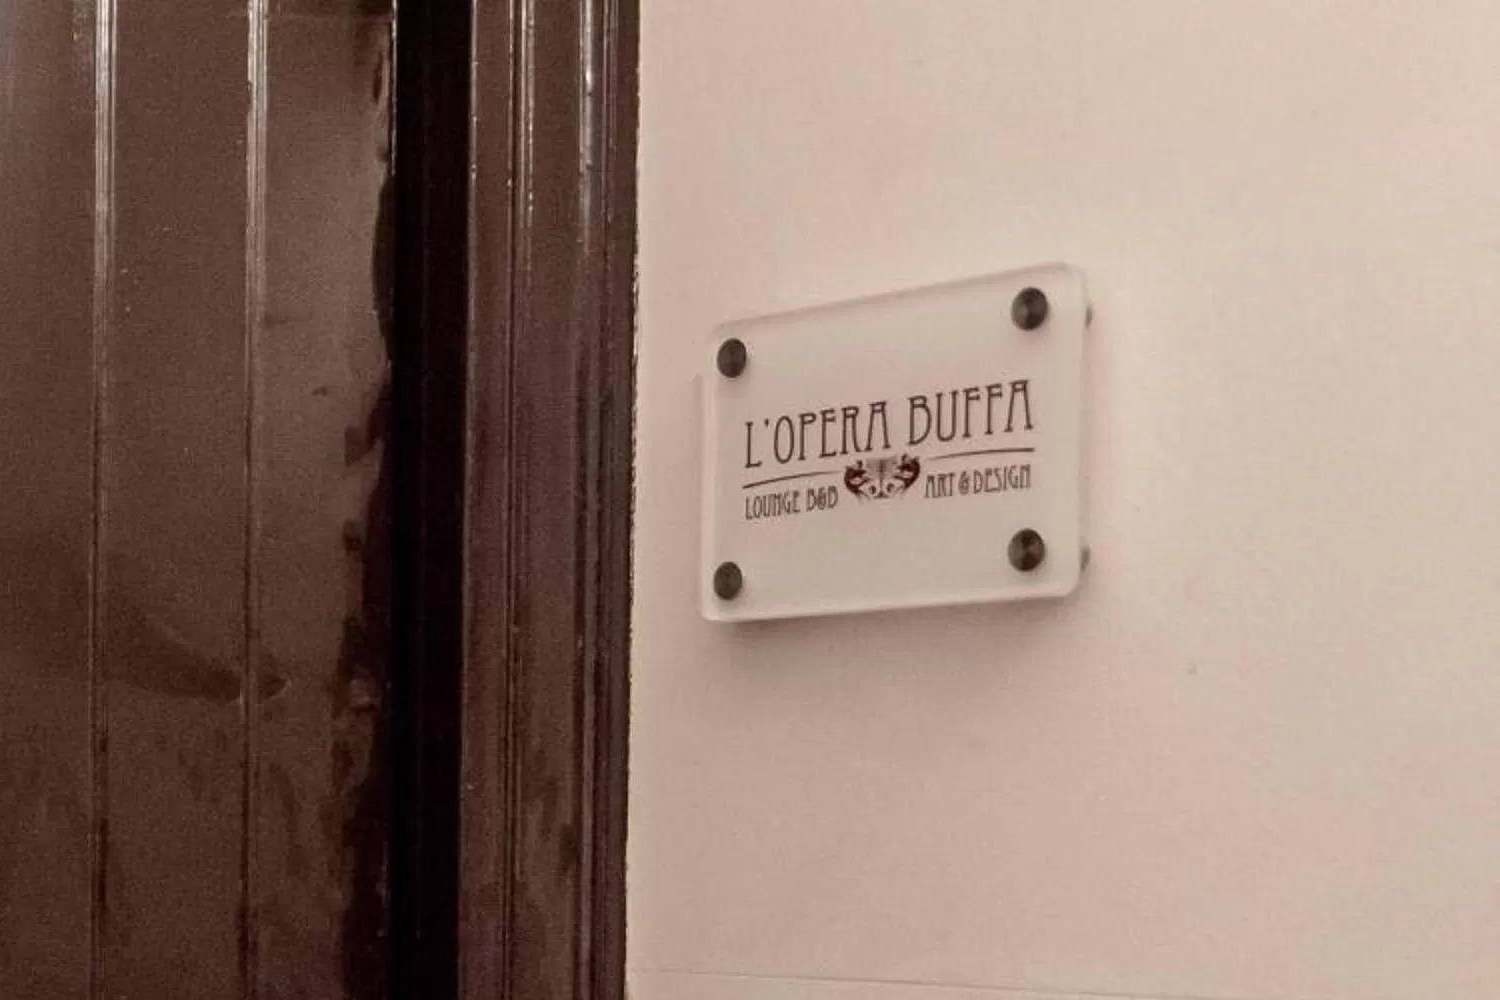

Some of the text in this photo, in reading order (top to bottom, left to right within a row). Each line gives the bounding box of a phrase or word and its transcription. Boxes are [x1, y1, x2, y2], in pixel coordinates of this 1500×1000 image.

[745, 379, 1034, 469] L'OPERA BUFFA
[924, 472, 955, 498] ART
[972, 464, 1031, 494] DESIGN
[745, 490, 800, 520] LOUNGE
